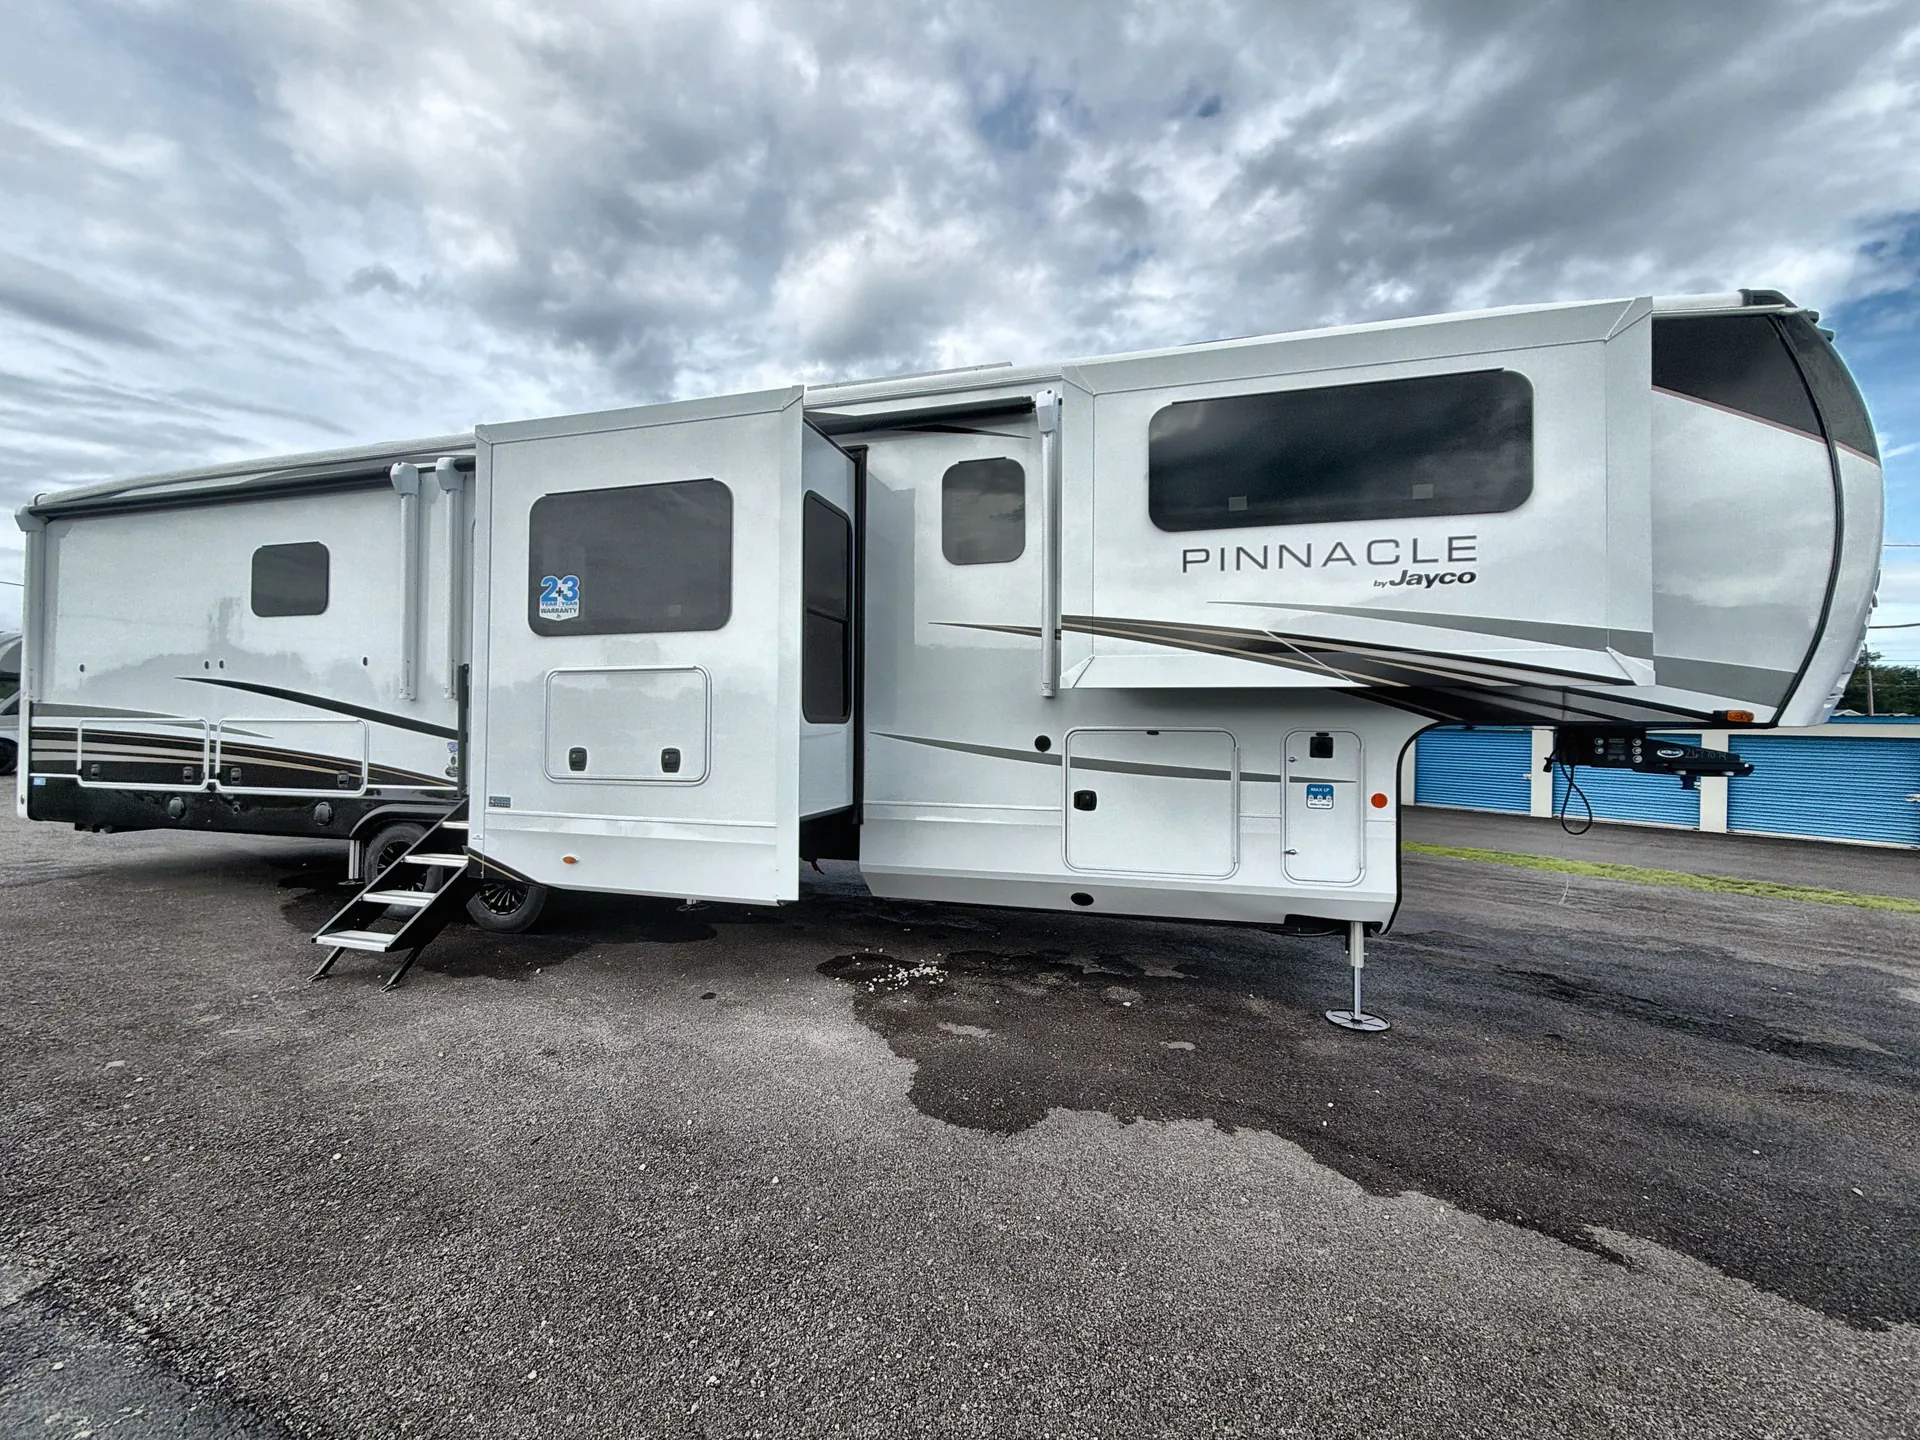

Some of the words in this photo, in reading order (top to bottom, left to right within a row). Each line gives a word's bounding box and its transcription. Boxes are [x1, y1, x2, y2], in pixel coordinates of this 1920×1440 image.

[1182, 535, 1478, 573] PINNACLE
[1373, 580, 1388, 588] by
[1389, 569, 1477, 589] Jayco
